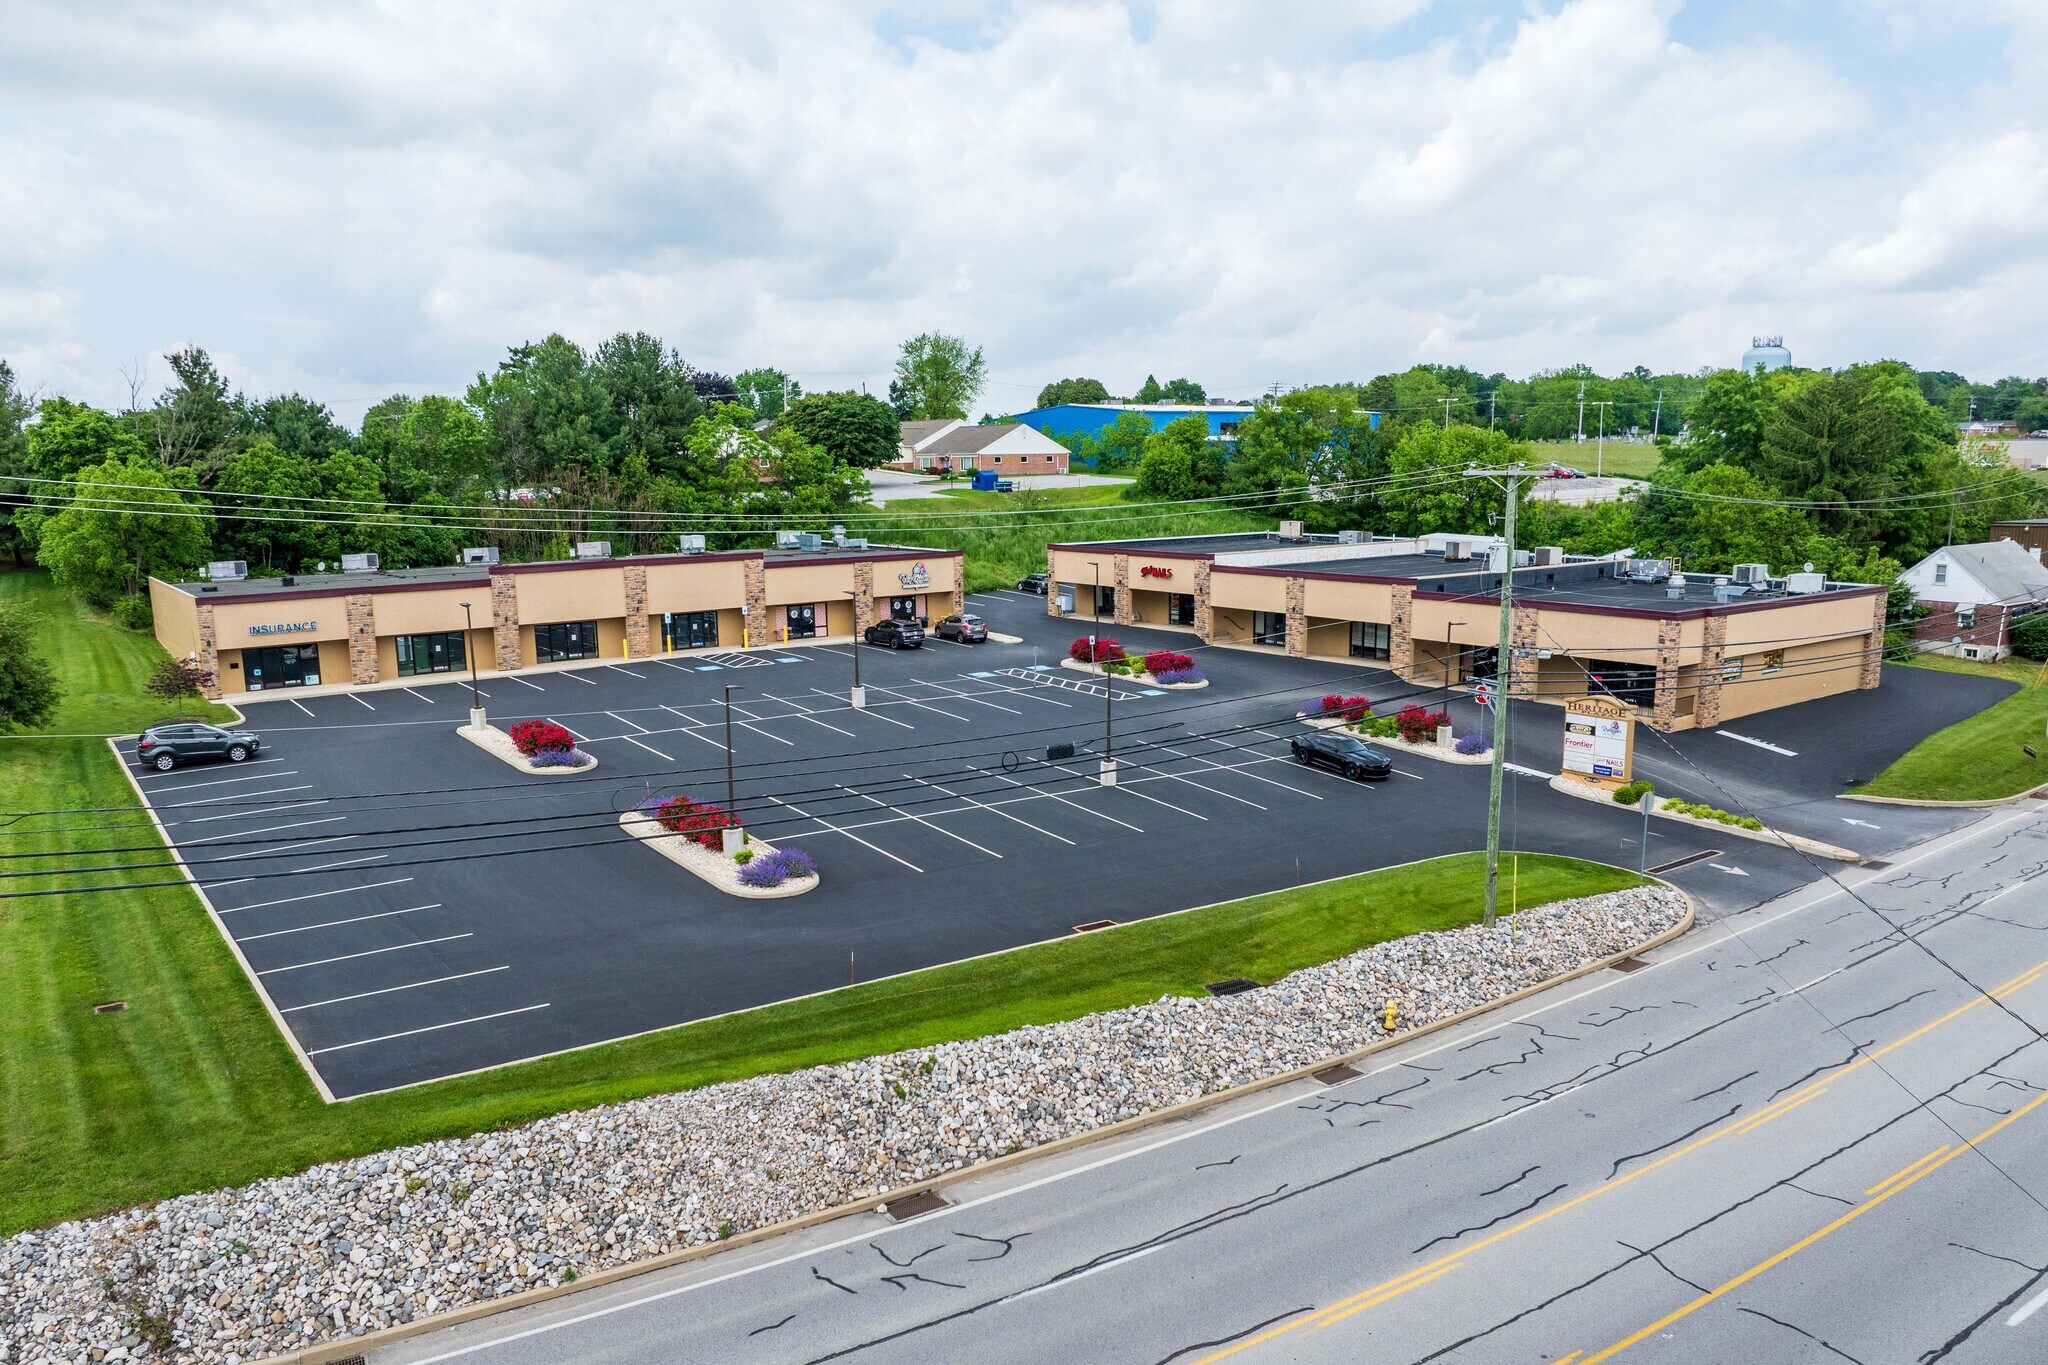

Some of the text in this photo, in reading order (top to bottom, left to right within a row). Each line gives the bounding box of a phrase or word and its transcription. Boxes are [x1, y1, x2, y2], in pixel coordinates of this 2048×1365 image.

[248, 621, 318, 635] INSURANCE
[1568, 702, 1626, 718] HERITAGE
[1582, 710, 1614, 718] PLAZA
[1565, 737, 1593, 749] Frontier
[1605, 758, 1624, 767] NAILS
